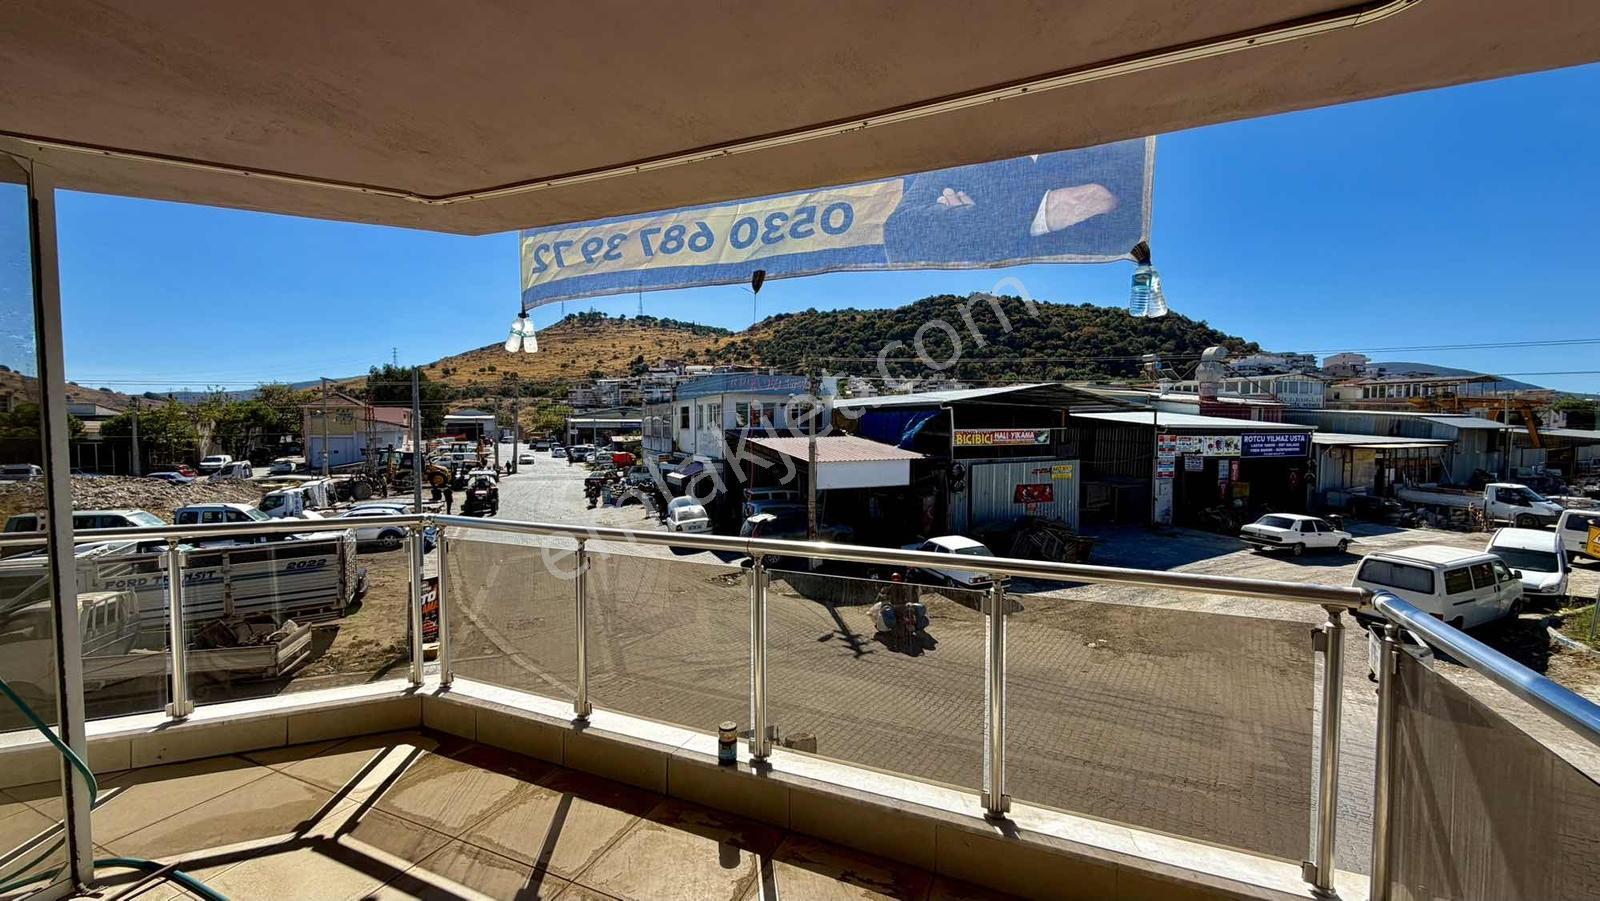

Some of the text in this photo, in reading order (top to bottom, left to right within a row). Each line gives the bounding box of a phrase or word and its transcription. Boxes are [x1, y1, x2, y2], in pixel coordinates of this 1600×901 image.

[1244, 435, 1265, 443] ROTCU
[1290, 434, 1305, 442] USTA
[286, 559, 327, 570] 2022
[104, 570, 216, 590] FORD TRNSIT
